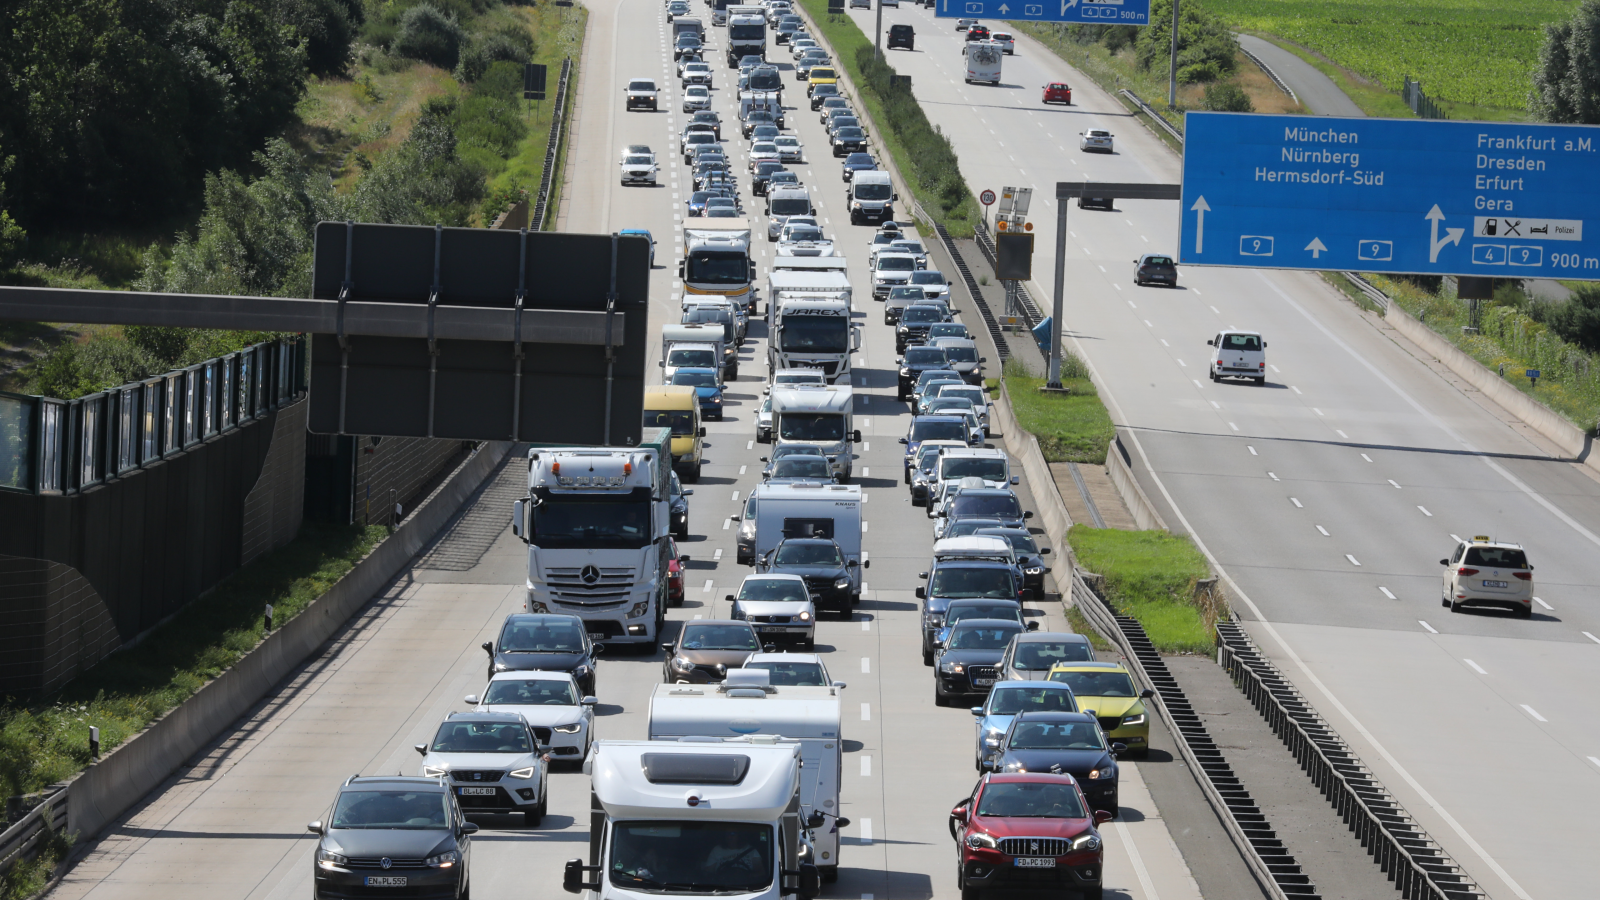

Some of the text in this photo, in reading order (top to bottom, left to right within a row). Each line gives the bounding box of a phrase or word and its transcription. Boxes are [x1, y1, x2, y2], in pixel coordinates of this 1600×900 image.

[1120, 11, 1135, 19] 500
[1284, 127, 1358, 143] München
[1477, 134, 1596, 152] Frankfurt a.M.
[1281, 147, 1359, 167] Nürnberg
[1476, 154, 1546, 171] Dresden
[1255, 167, 1384, 186] Hermsdorf-Süd
[1475, 175, 1524, 190] Erfurt
[1475, 196, 1513, 211] Gera
[1555, 226, 1575, 234] Polizei
[1253, 240, 1261, 252] 9
[1372, 244, 1380, 256] 9
[1485, 248, 1494, 261] 4
[1521, 249, 1530, 262] 9
[1551, 253, 1599, 269] 900 m
[1039, 858, 1055, 866] 1993
